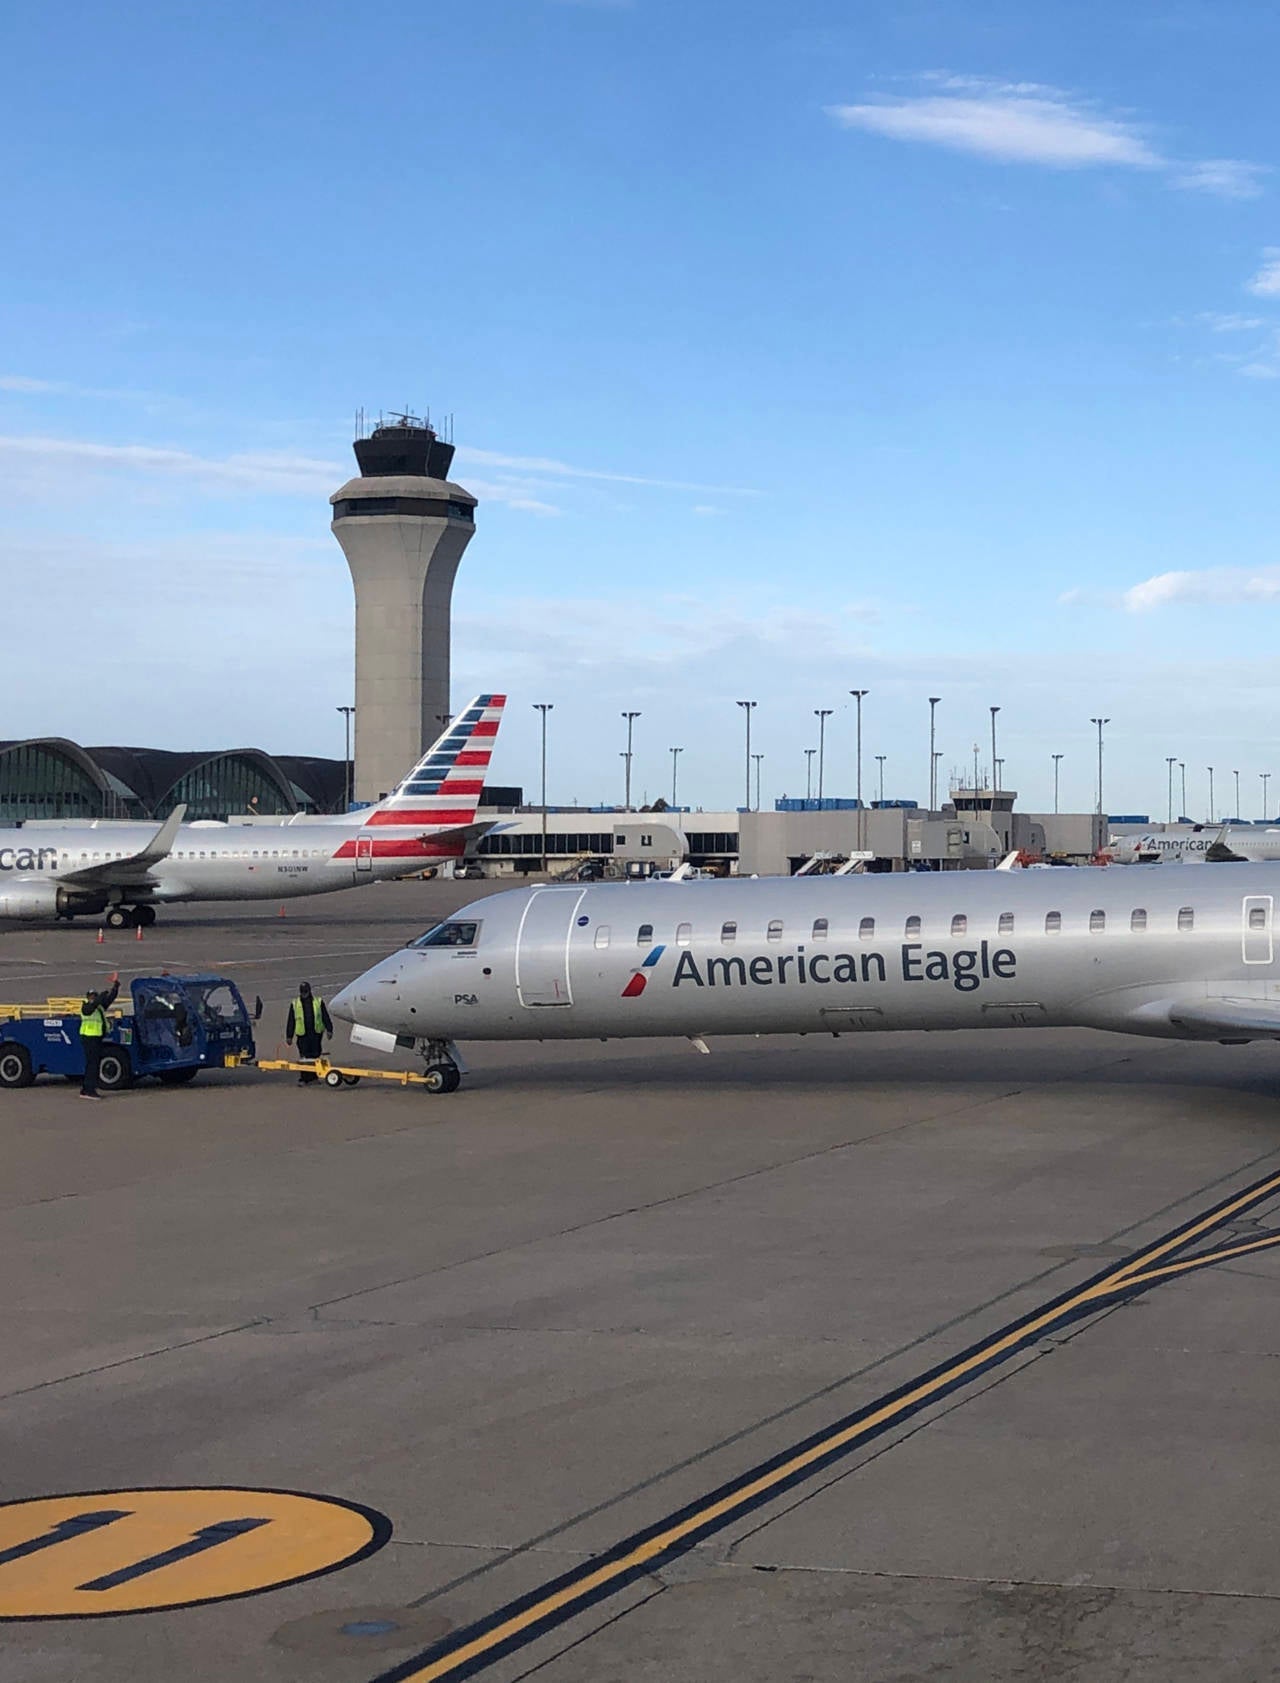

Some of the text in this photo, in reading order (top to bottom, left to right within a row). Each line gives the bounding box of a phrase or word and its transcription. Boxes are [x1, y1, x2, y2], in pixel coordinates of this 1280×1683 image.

[672, 940, 1017, 992] American Eagle
[454, 994, 478, 1005] PSA
